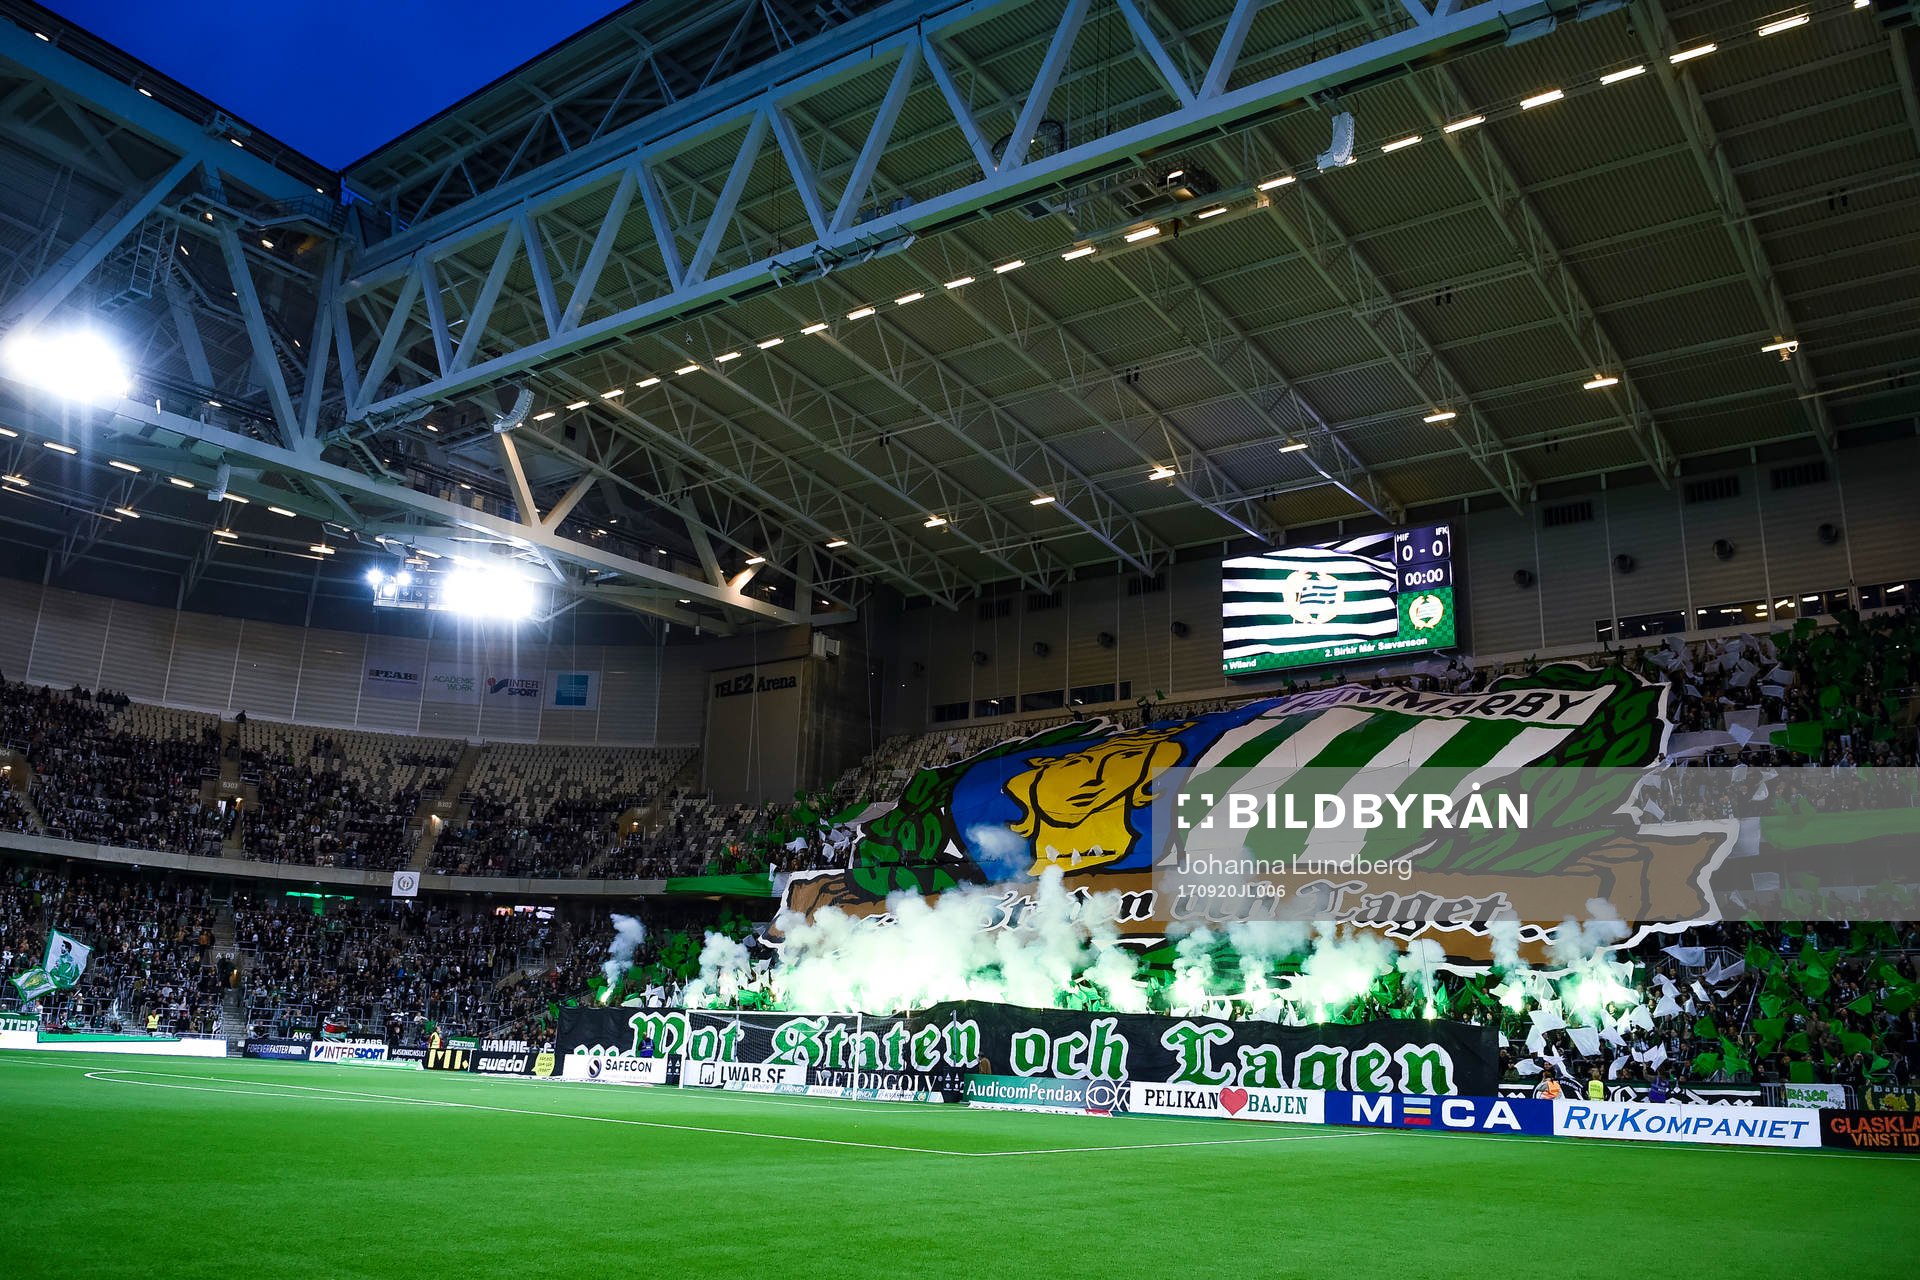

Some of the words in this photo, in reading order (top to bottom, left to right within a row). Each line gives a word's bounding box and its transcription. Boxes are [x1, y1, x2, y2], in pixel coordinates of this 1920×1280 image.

[1396, 532, 1410, 542] HIF
[1402, 545, 1413, 561] 0
[1432, 540, 1443, 557] 0
[1404, 568, 1444, 586] 00:00
[1324, 648, 1333, 658] 2.
[1333, 646, 1358, 657] Birkir
[1229, 658, 1257, 670] Wiland
[508, 678, 539, 689] INTER
[714, 673, 754, 698] TELE2
[757, 675, 797, 693] Arena
[507, 688, 539, 698] SPORT
[1284, 685, 1592, 721] HAMMARBY
[323, 1044, 385, 1060] INTERSPORT
[762, 1015, 982, 1072] Staten
[1009, 1017, 1129, 1082] och
[1159, 1020, 1459, 1096] Lagen
[477, 1055, 529, 1073] swedol
[966, 1079, 1083, 1103] AudicomPendax
[1144, 1088, 1219, 1111] PELIKAN
[1247, 1094, 1308, 1115] BAJEN
[1351, 1094, 1522, 1131] MECA
[1851, 1132, 1901, 1147] VINST
